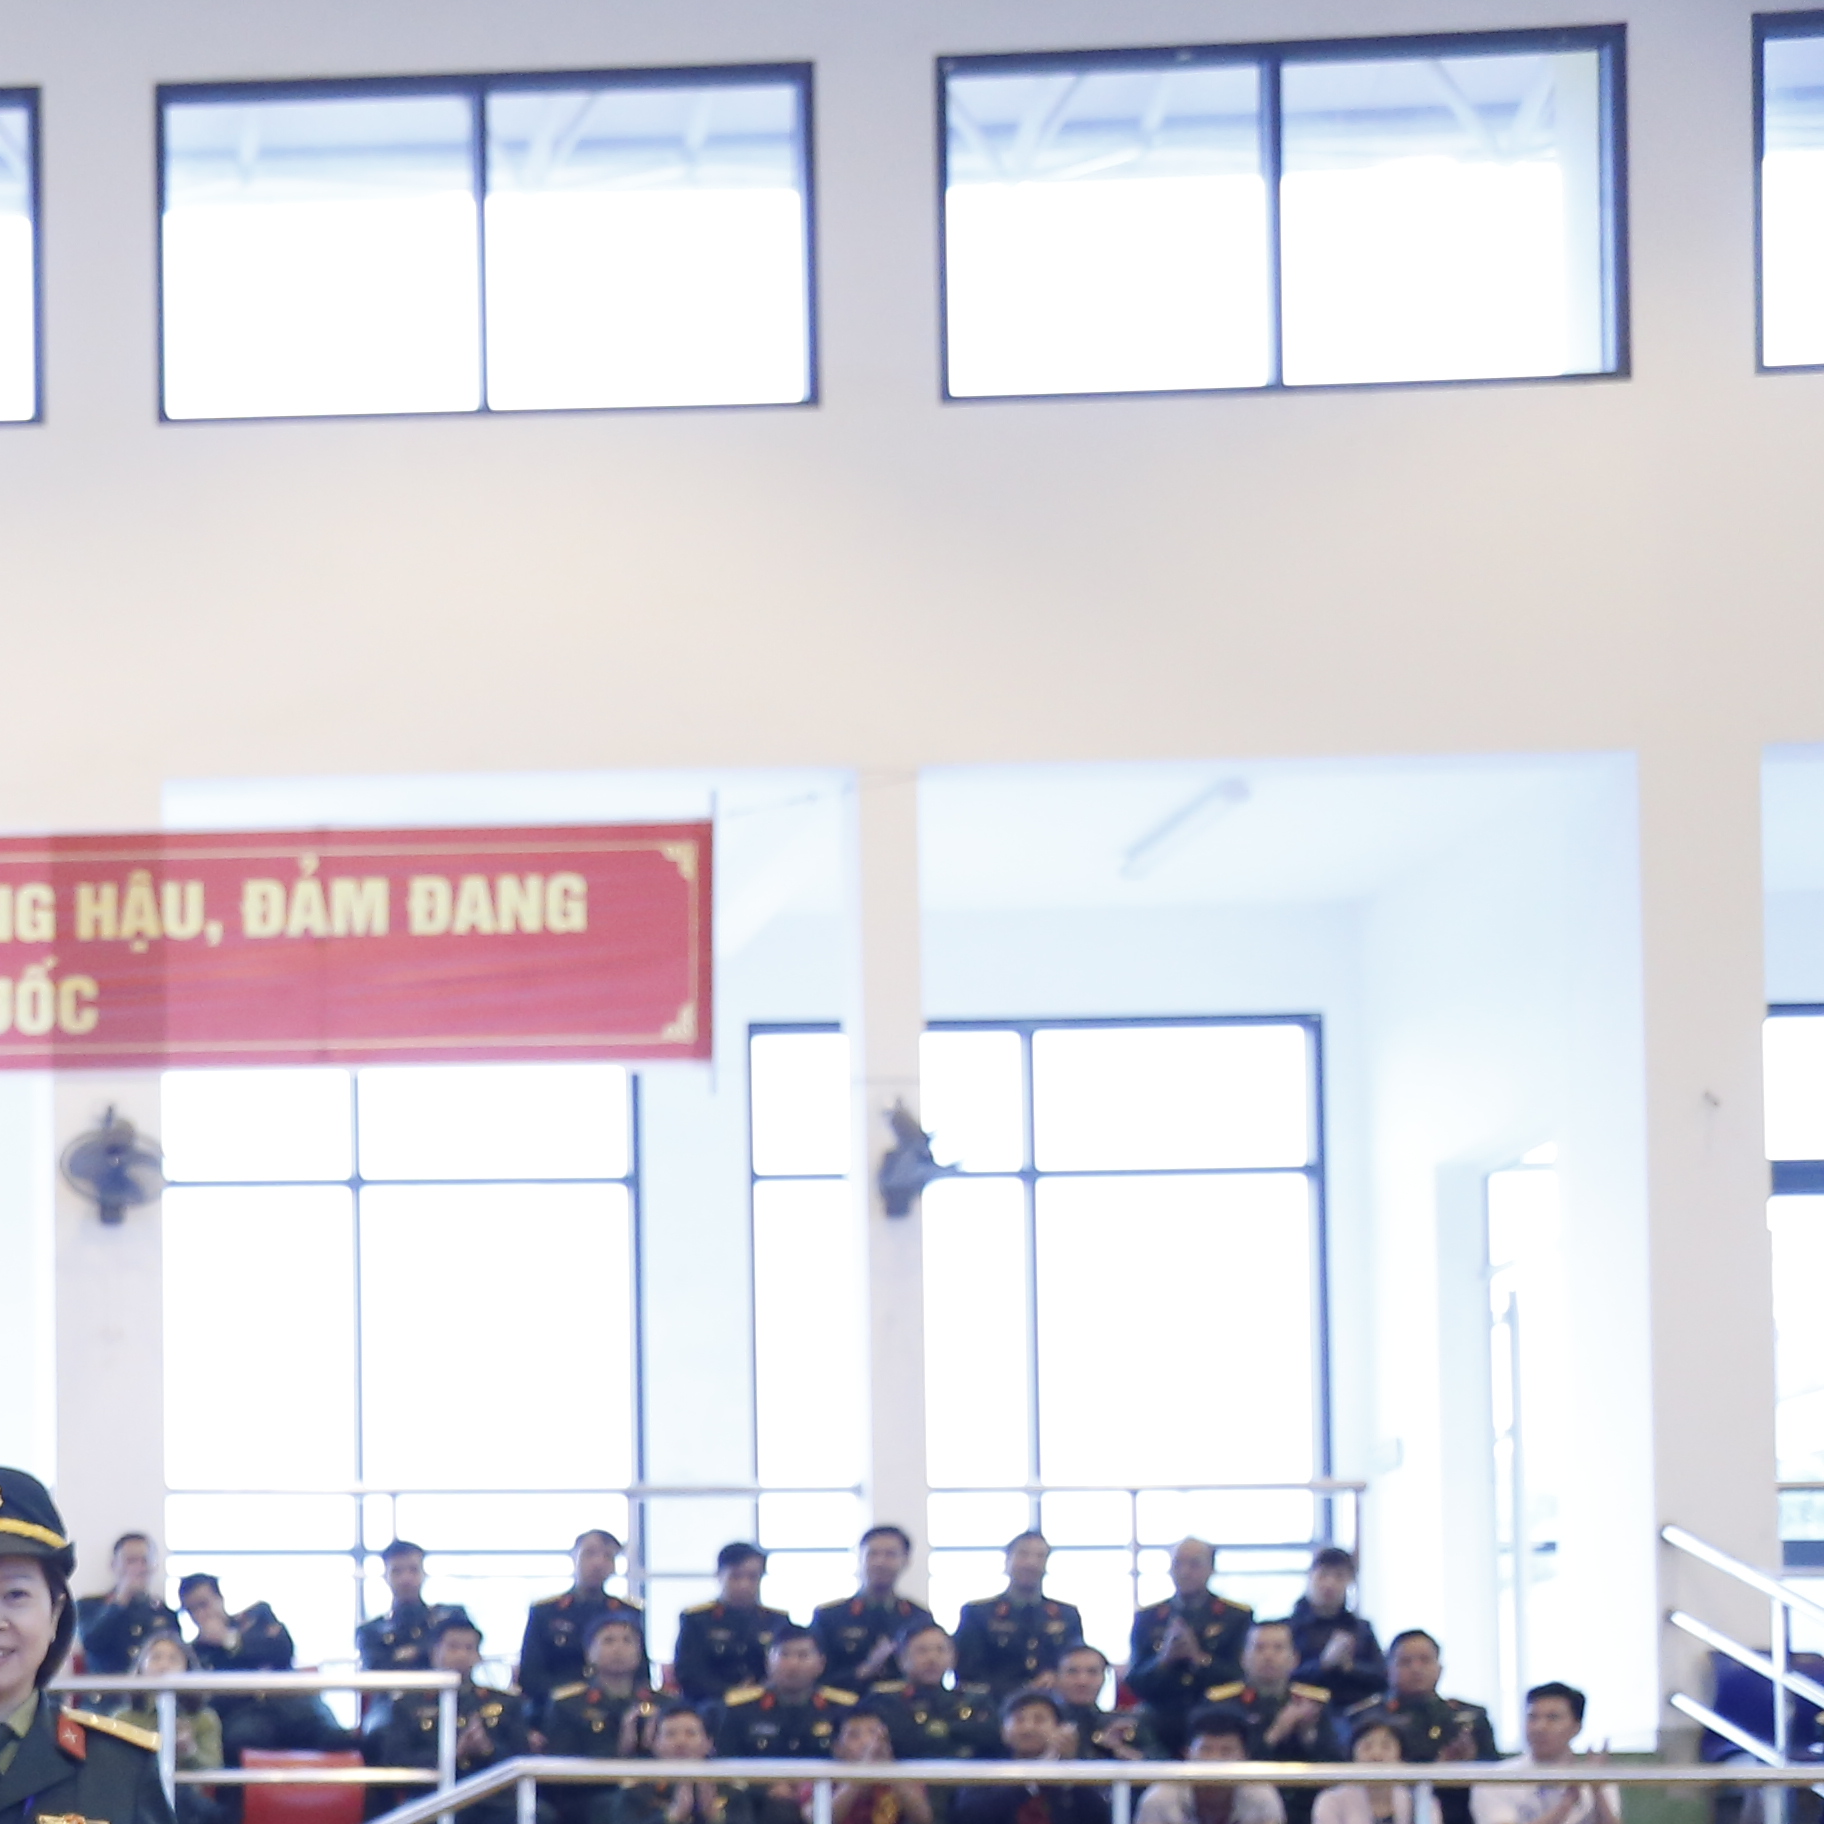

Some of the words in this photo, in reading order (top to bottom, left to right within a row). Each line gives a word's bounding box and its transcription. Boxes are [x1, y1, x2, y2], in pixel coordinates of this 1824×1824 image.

[75, 873, 222, 953] HẬU,
[242, 853, 388, 938] ĐẢM
[406, 873, 588, 933] ĐANG
